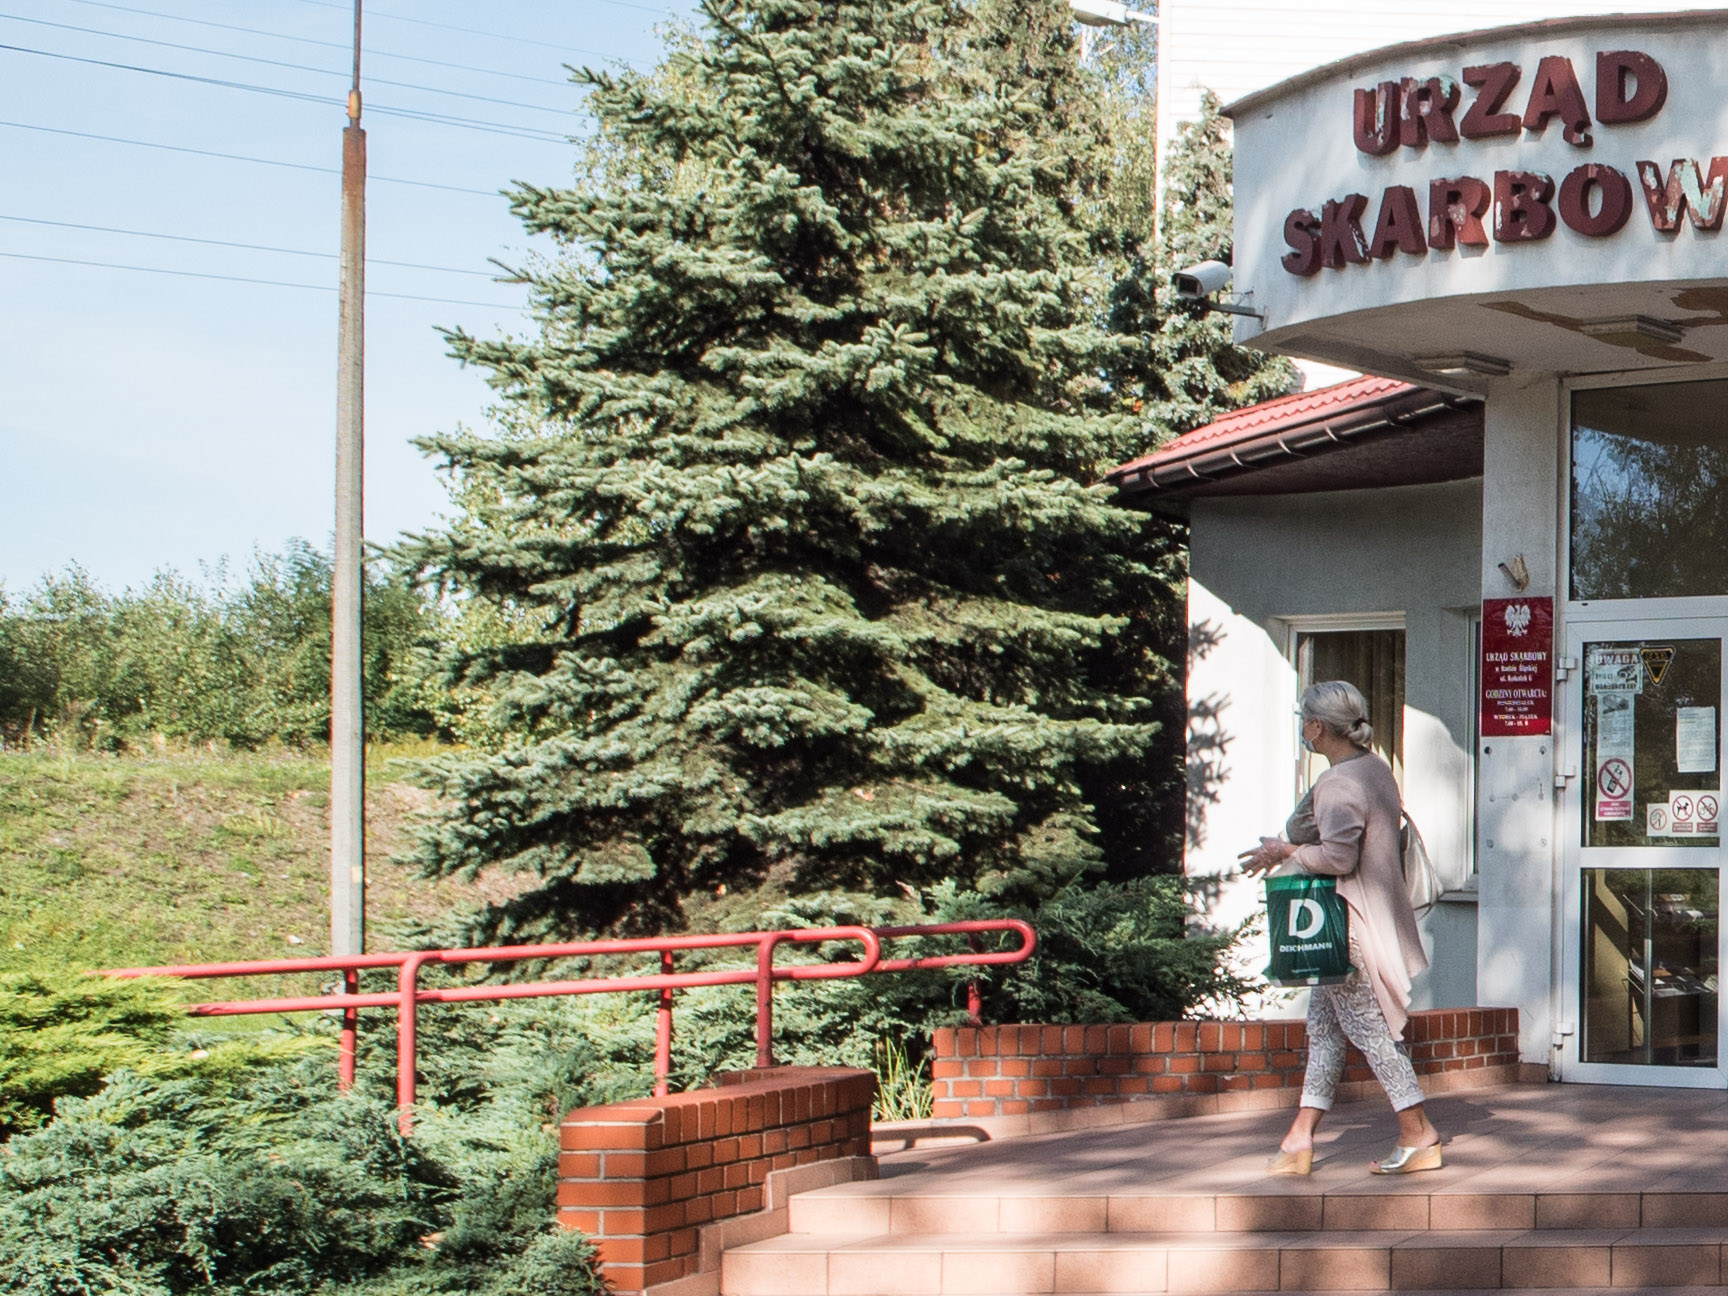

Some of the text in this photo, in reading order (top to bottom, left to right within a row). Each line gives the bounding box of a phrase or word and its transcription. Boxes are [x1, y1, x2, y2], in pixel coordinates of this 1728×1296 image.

[1353, 50, 1668, 155] URZĄD
[1595, 653, 1639, 665] UWAGA
[1279, 942, 1332, 952] DEICHMANN
